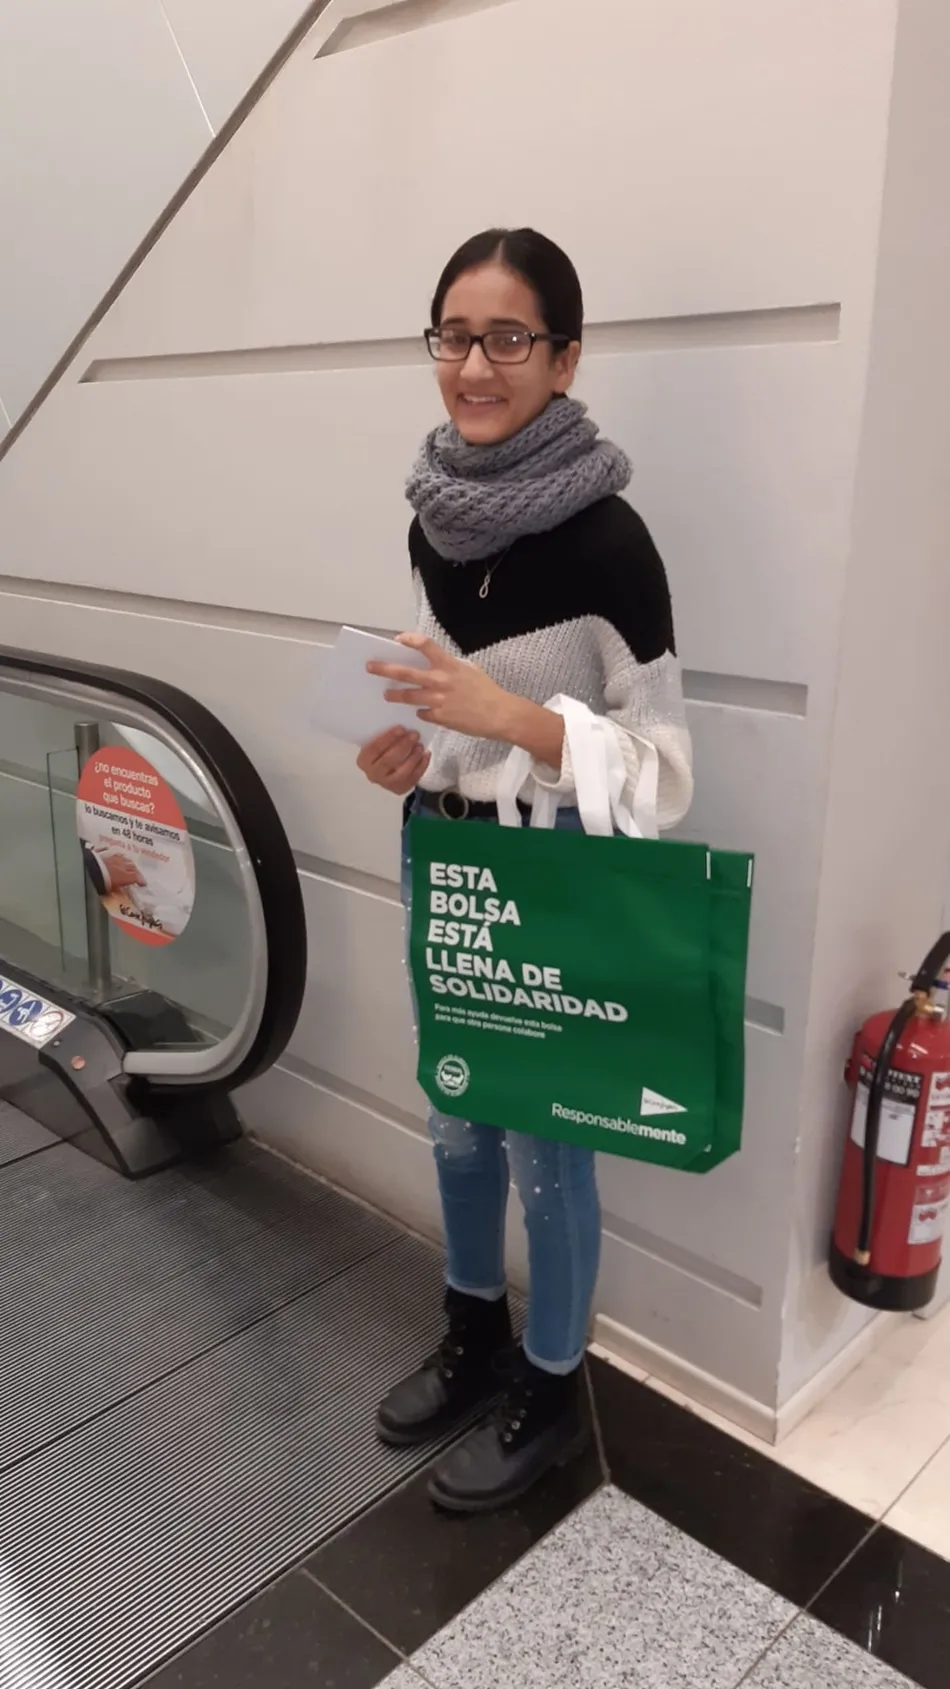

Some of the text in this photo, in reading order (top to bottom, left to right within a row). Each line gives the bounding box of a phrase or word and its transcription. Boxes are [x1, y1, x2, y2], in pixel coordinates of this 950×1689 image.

[104, 777, 151, 799] el producto
[111, 765, 159, 786] encuentras
[103, 792, 155, 814] que buscas?
[84, 803, 92, 814] lo
[92, 805, 128, 825] buscamos
[135, 819, 143, 830] te
[144, 823, 180, 841] avisamos
[111, 826, 154, 846] en 48 horas
[430, 862, 498, 893] ESTA
[430, 890, 521, 926] BOLSA
[427, 919, 494, 952] ESTÁ
[426, 947, 563, 991] LLENA DE
[429, 974, 628, 1022] SOLIDARIDAD
[434, 1002, 451, 1013] Para
[467, 1009, 489, 1020] ayuda
[490, 1013, 523, 1025] devuelve
[524, 1019, 540, 1028] esta
[541, 1021, 563, 1032] bolsa
[435, 1013, 451, 1023] para
[451, 1016, 466, 1025] que
[467, 1018, 482, 1028] otra
[482, 1021, 512, 1033] persona
[552, 1102, 687, 1145] Responsablemente
